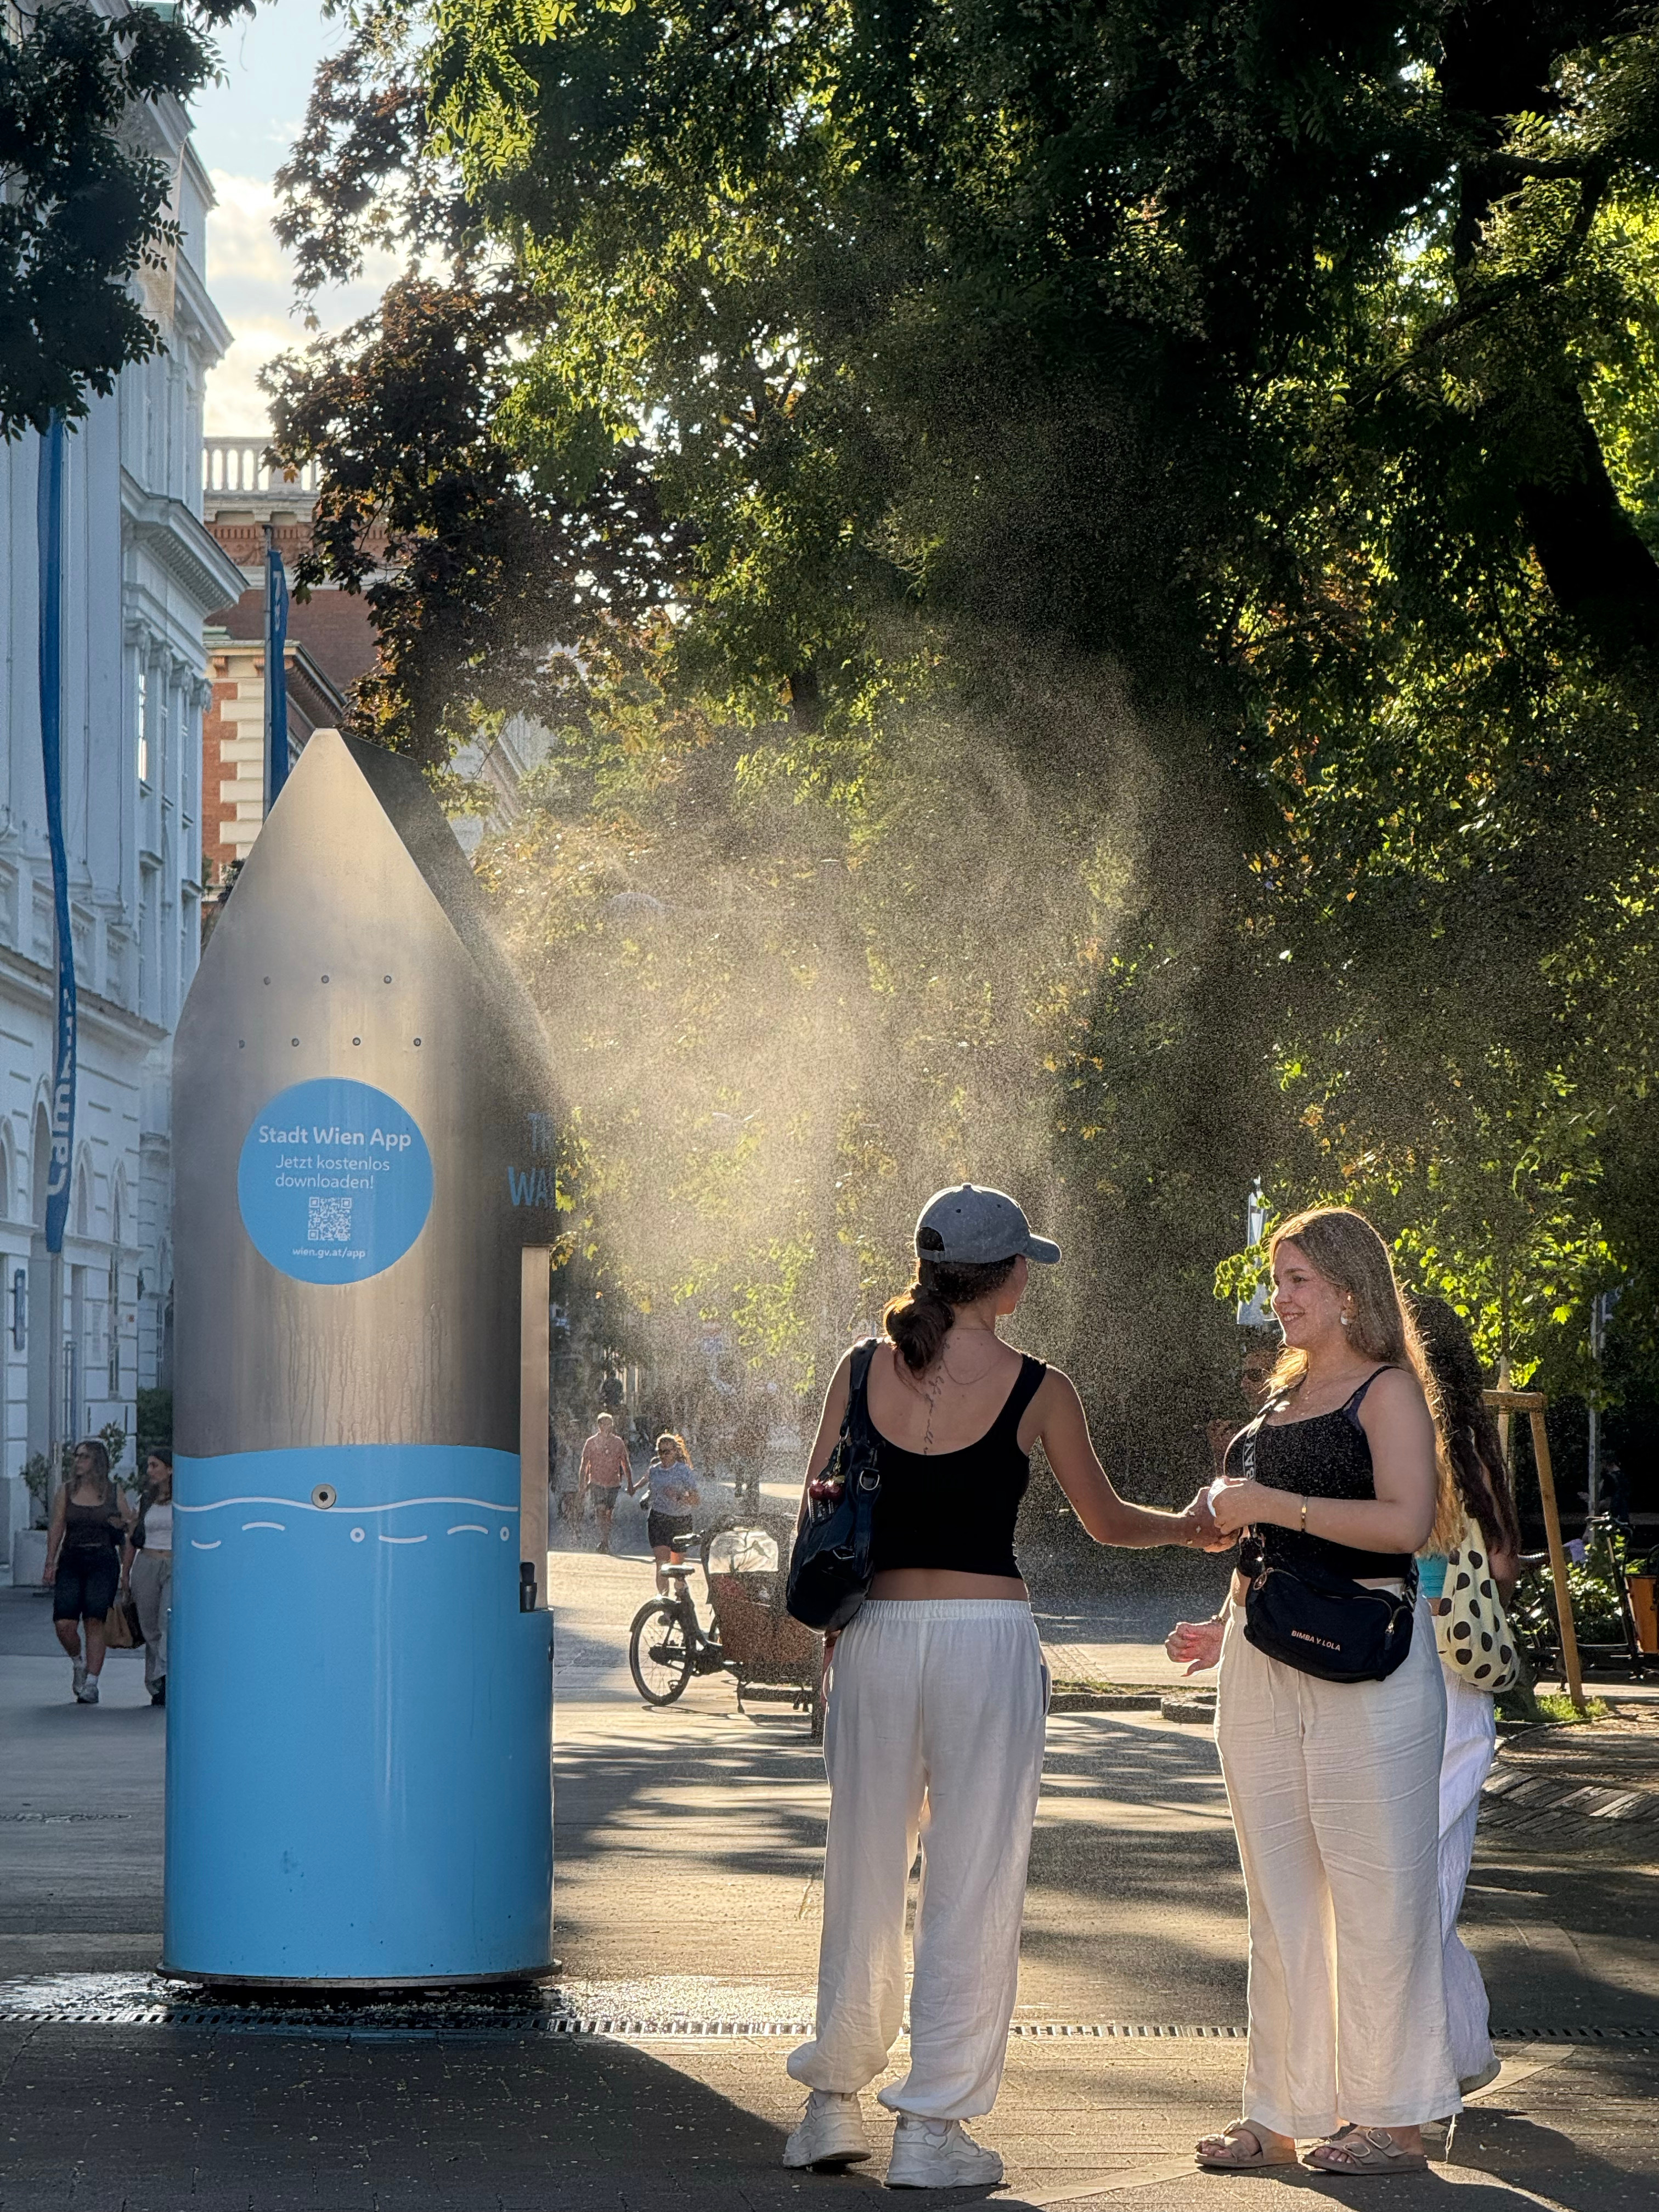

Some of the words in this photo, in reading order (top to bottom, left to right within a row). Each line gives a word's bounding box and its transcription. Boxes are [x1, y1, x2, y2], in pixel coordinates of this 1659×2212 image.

[258, 1125, 308, 1144] Stadt
[313, 1126, 365, 1146] Wien
[370, 1128, 411, 1152] App
[275, 1154, 312, 1169] Jetzt
[317, 1154, 390, 1171] kostenlos
[275, 1173, 374, 1189] downloaden!
[292, 1246, 366, 1259] wien.gv.at/app
[1291, 1630, 1314, 1643] BIMBA
[1322, 1640, 1341, 1652] LOLA
